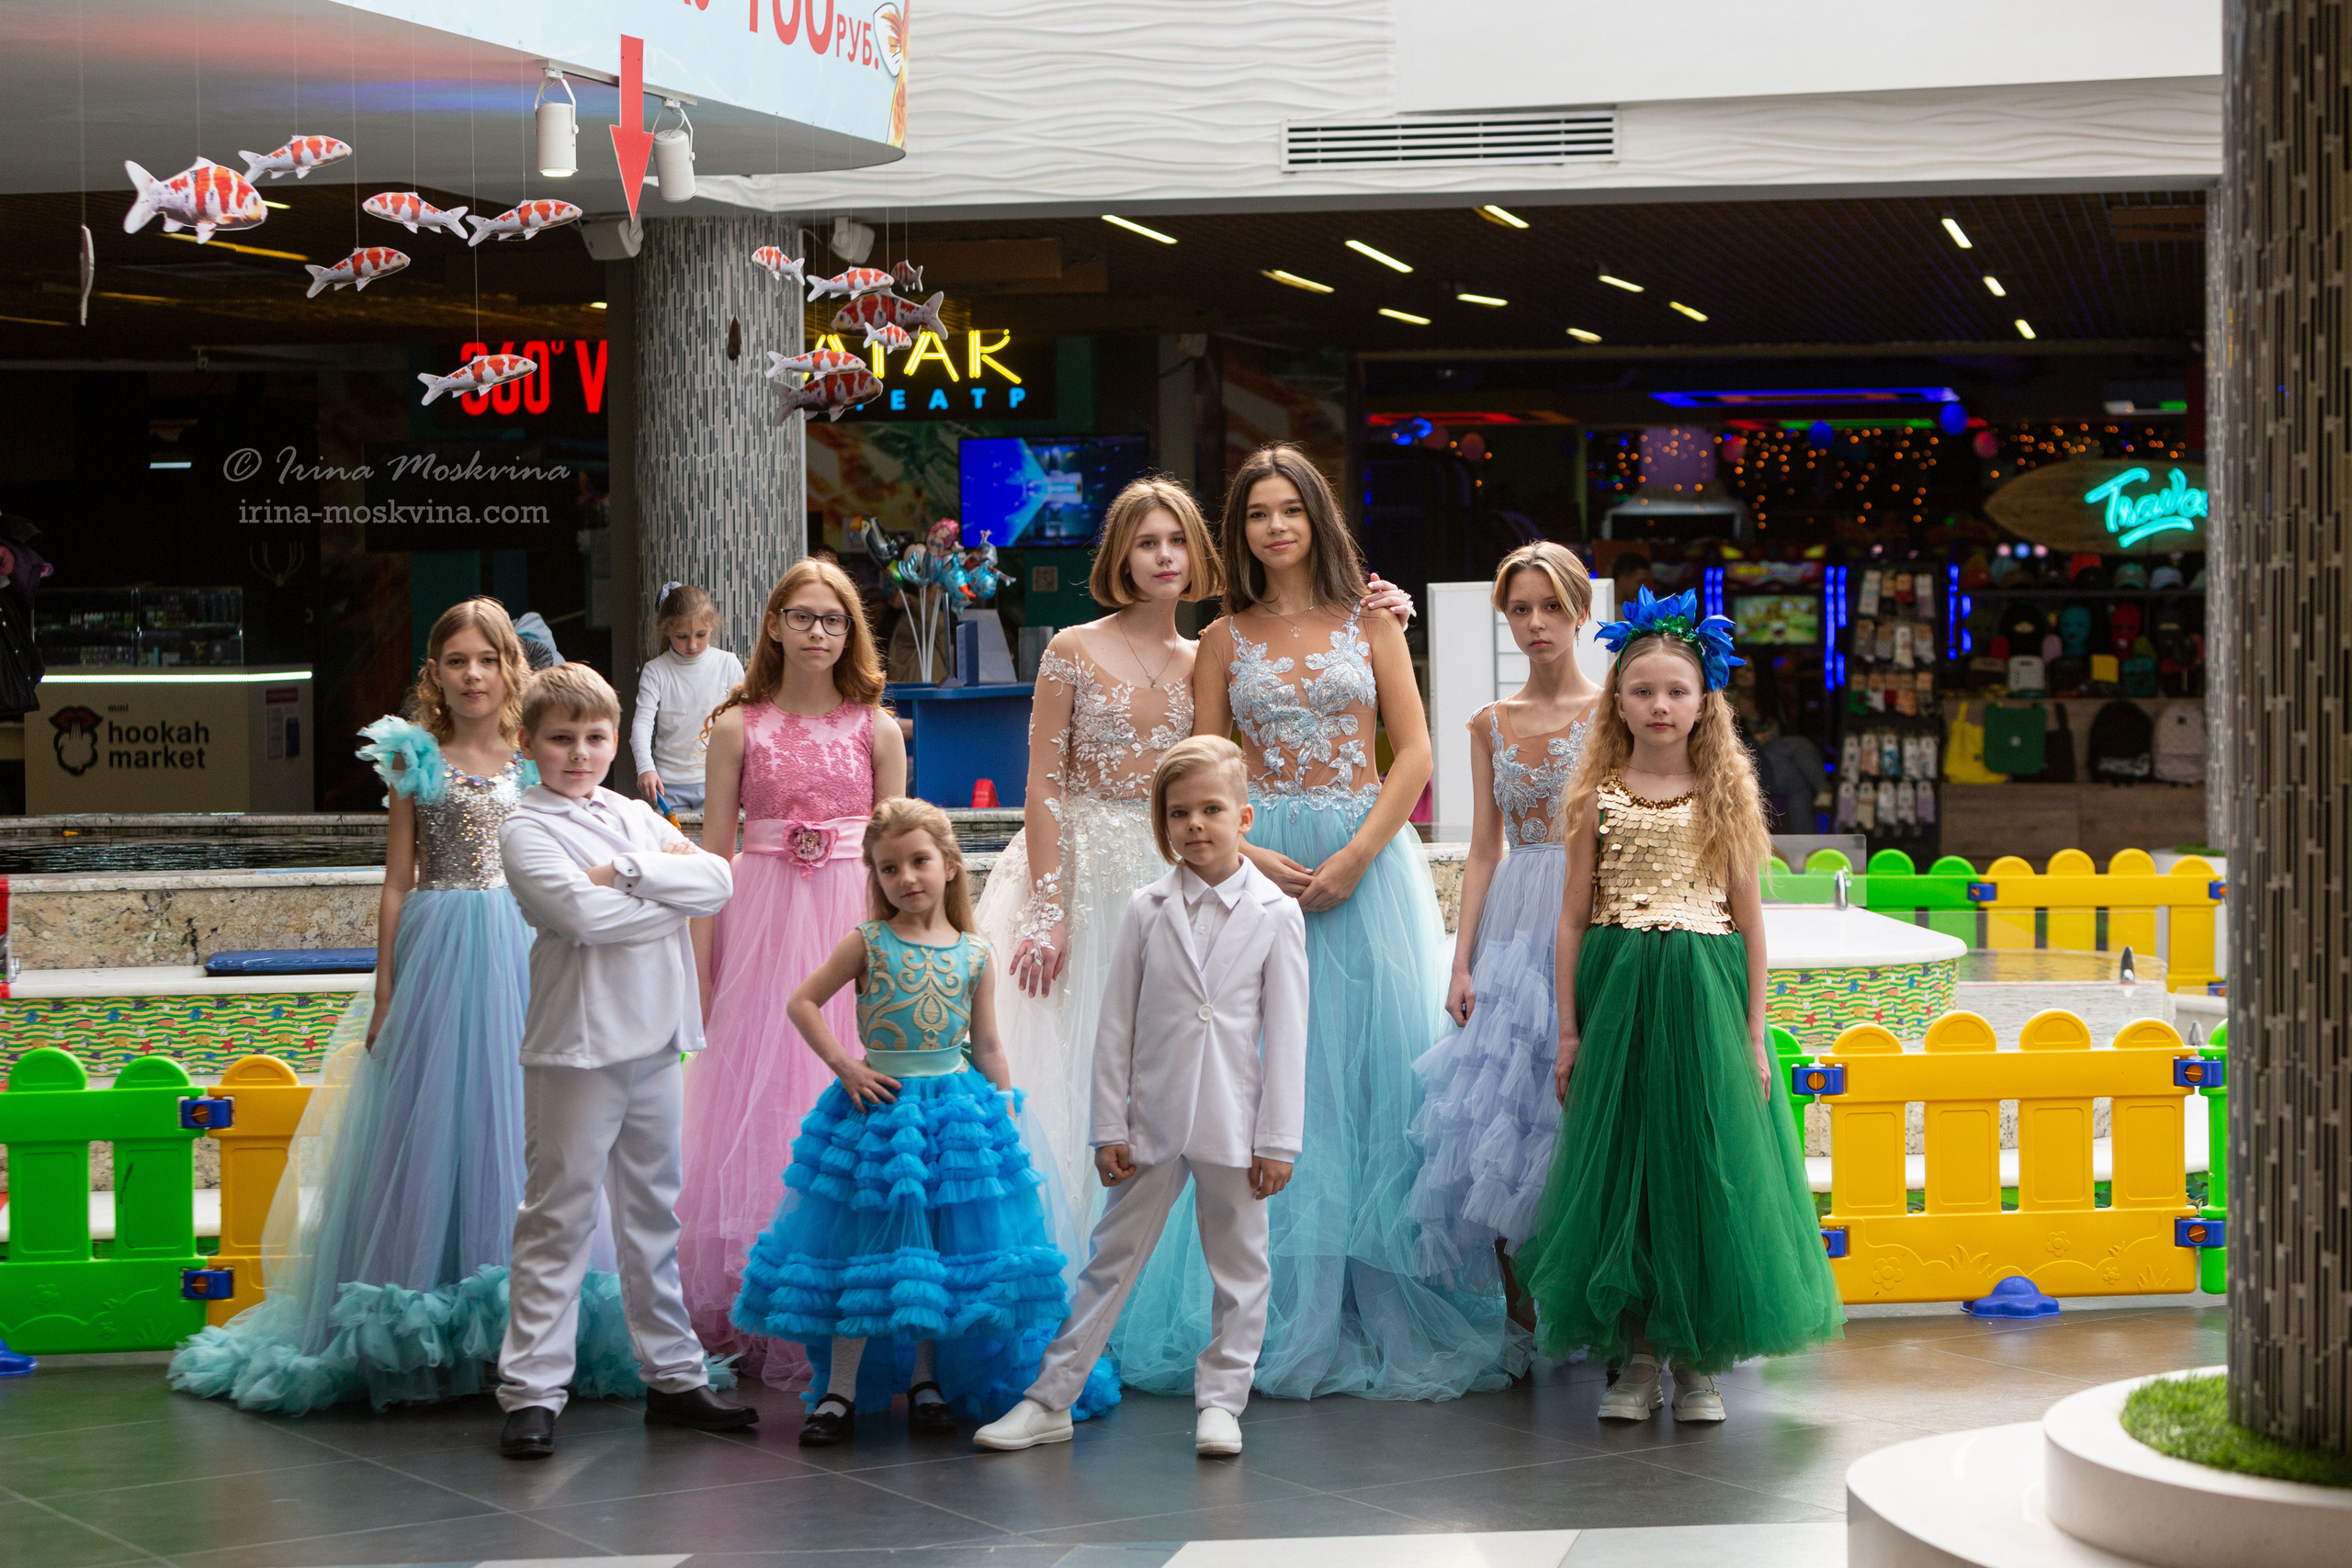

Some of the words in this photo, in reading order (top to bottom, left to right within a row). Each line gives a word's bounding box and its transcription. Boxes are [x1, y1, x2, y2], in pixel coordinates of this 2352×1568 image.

[836, 13, 879, 71] РУБ.
[855, 388, 1026, 412] ЕАТР
[107, 703, 130, 713] mini
[108, 719, 210, 744] hookah
[108, 744, 207, 769] market
